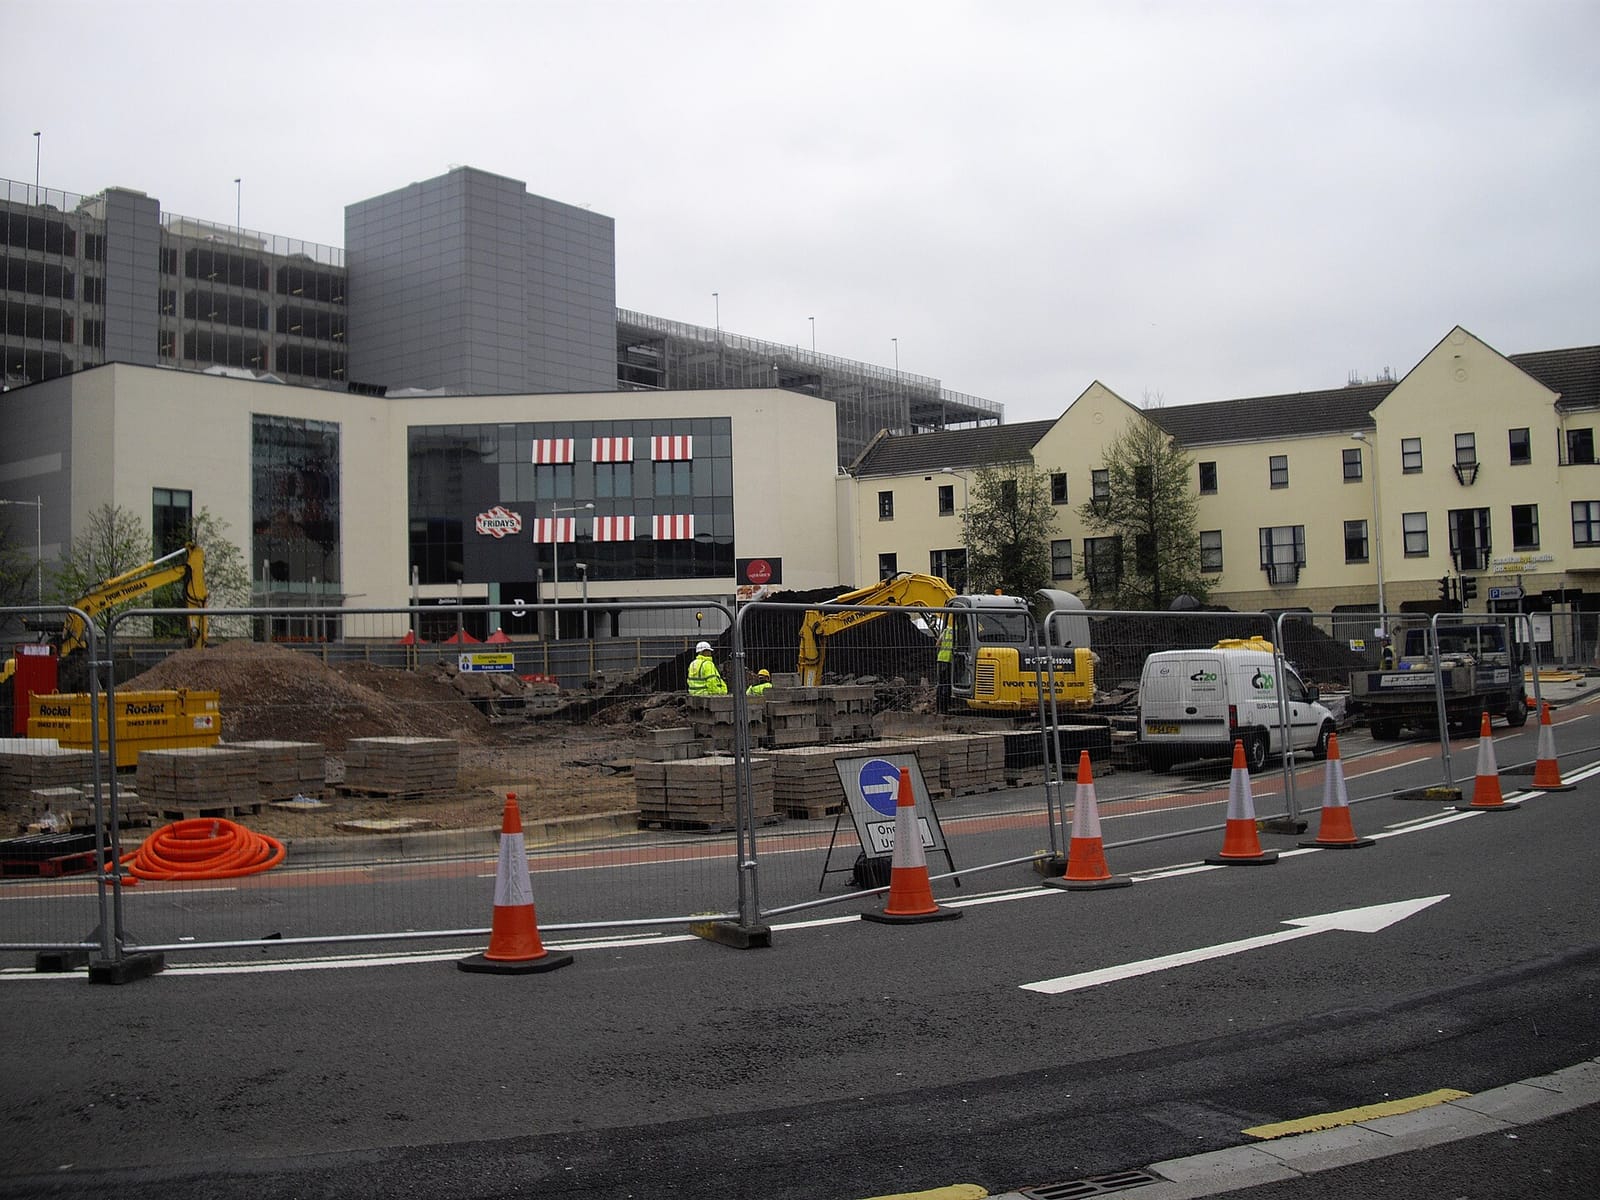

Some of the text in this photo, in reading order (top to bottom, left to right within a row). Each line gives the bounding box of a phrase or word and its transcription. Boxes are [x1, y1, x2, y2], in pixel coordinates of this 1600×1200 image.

[121, 581, 148, 595] THOMAS
[1002, 680, 1025, 688] IVOR
[39, 703, 71, 717] Rocket
[125, 702, 165, 716] Rocket
